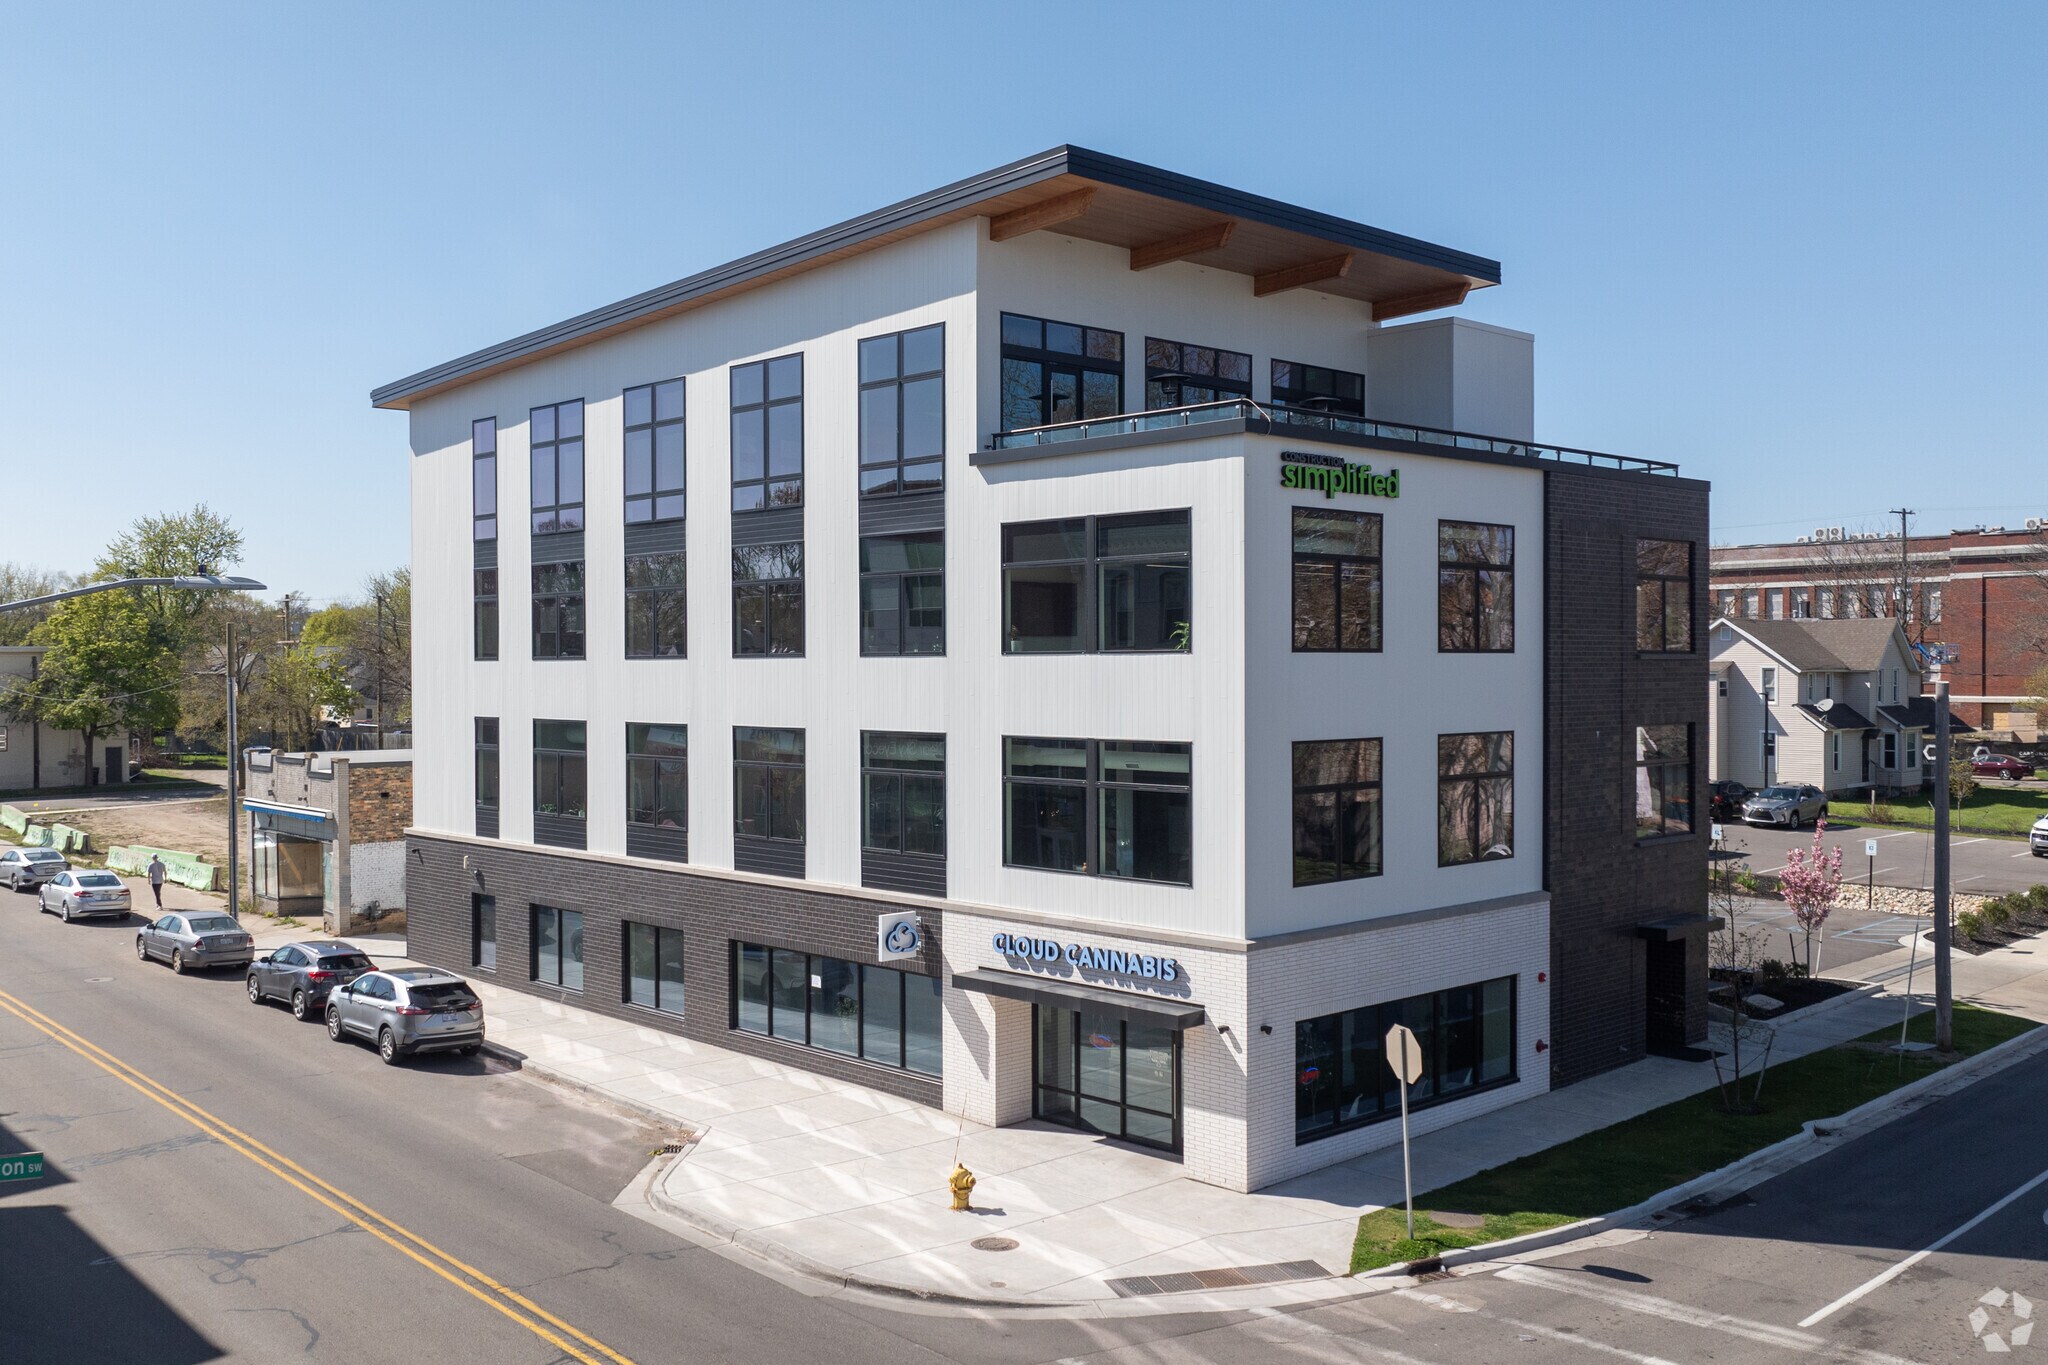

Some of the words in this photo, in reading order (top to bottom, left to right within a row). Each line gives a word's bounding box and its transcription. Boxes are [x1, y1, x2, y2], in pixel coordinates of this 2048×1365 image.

[1281, 451, 1345, 467] CONSTRUCTION
[1281, 463, 1400, 499] simplified
[993, 933, 1061, 962] CLOUD
[1065, 944, 1178, 982] CANNABIS
[0, 1162, 25, 1176] on
